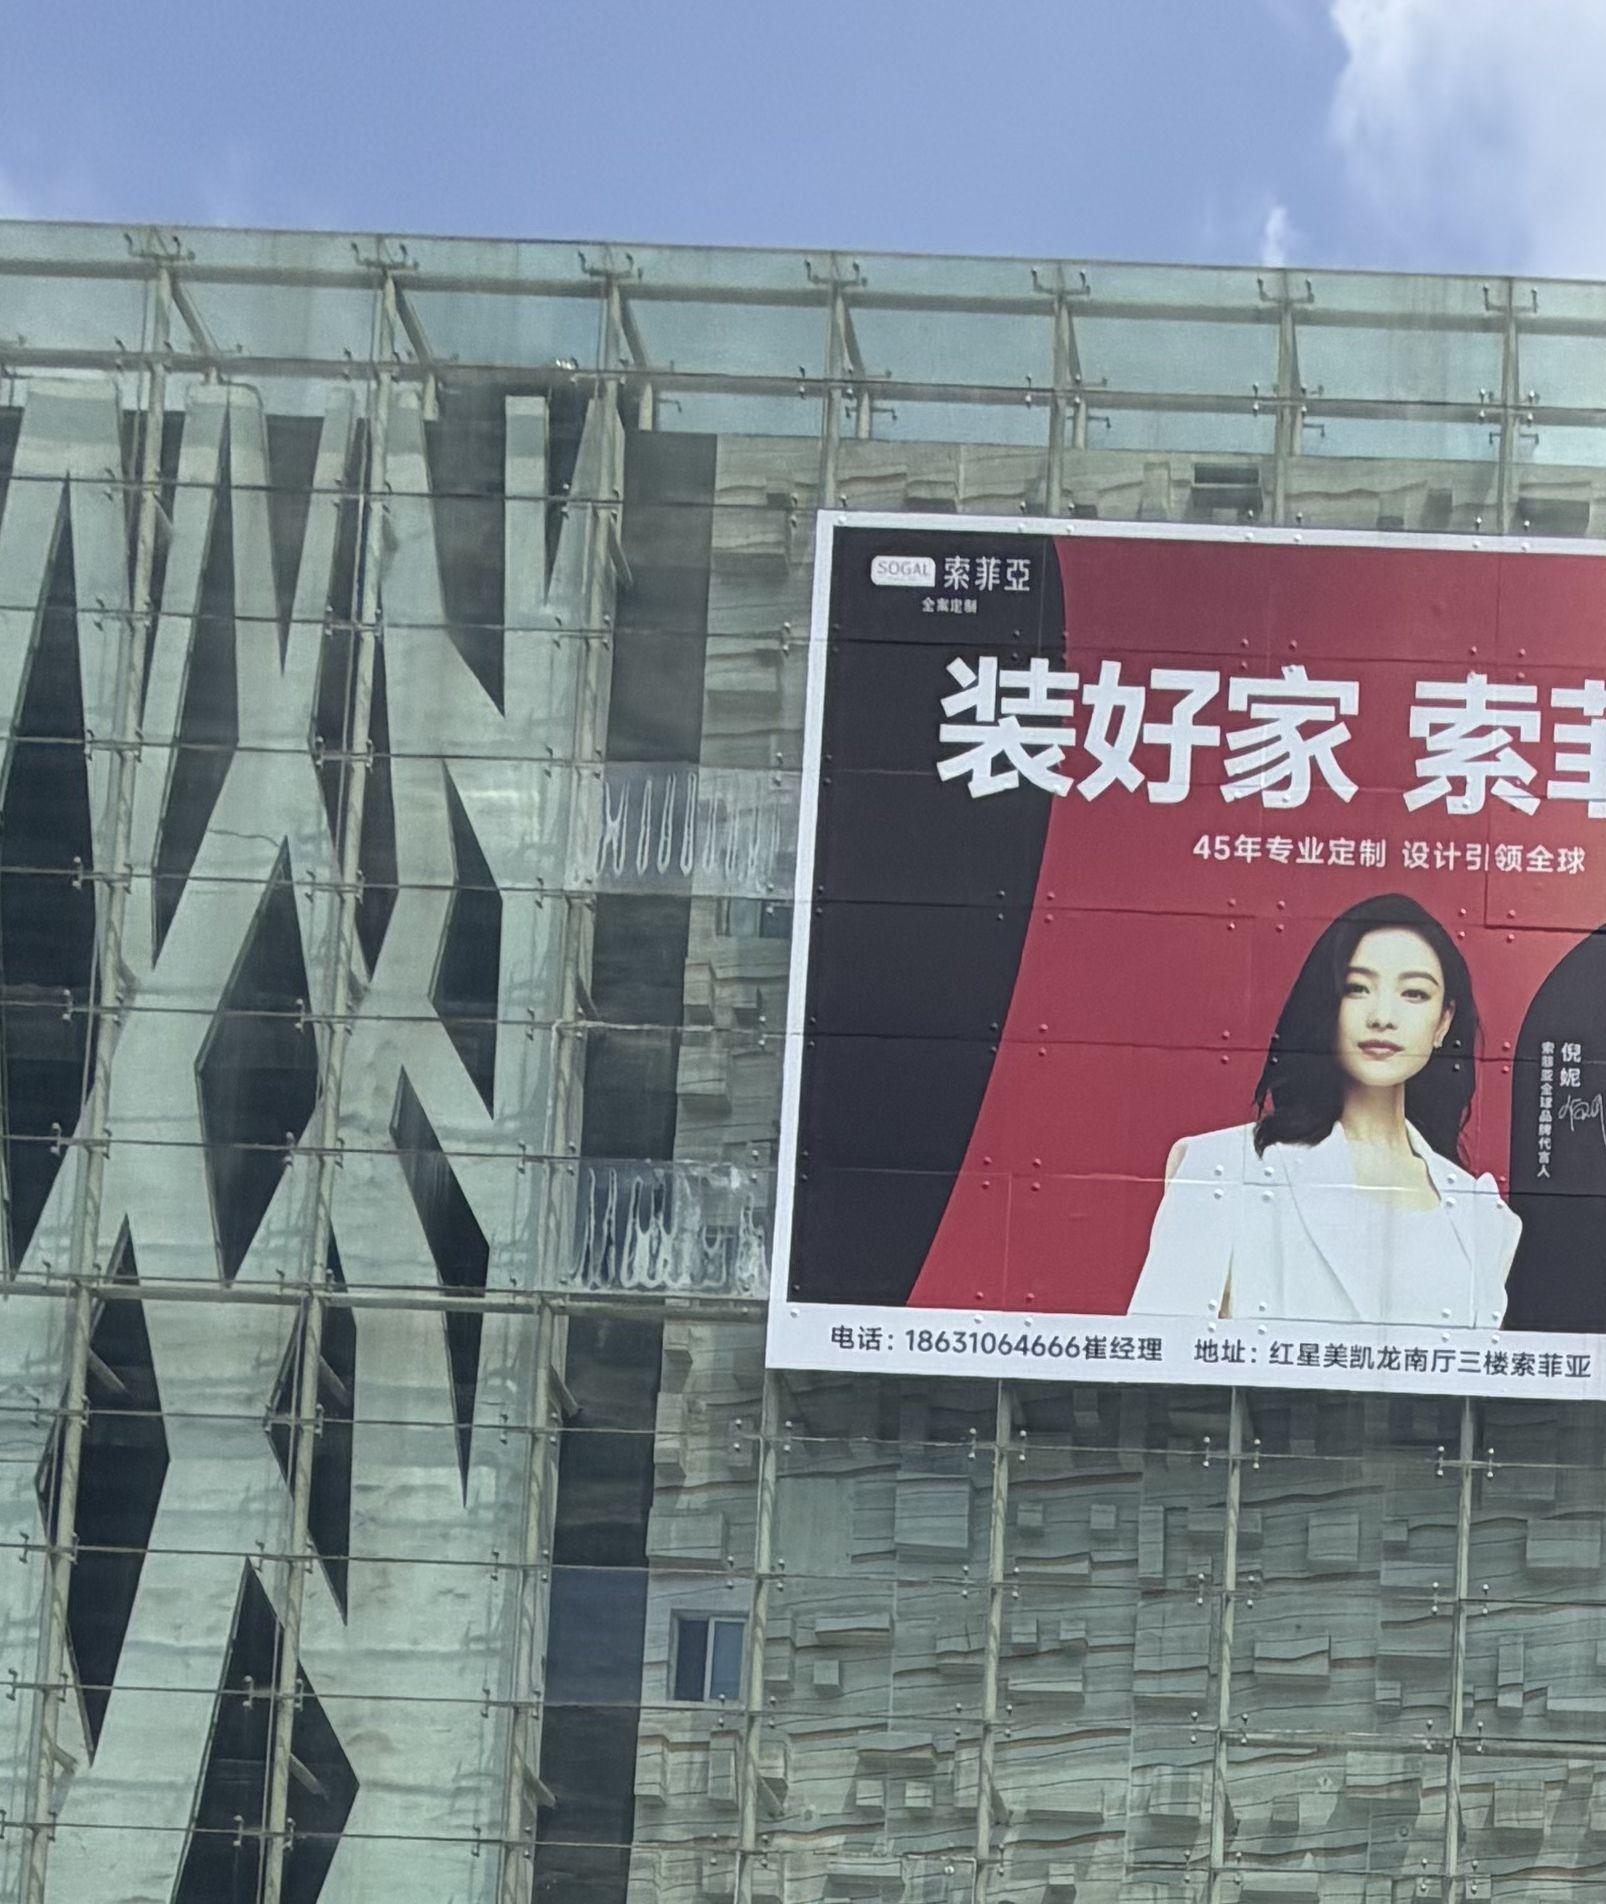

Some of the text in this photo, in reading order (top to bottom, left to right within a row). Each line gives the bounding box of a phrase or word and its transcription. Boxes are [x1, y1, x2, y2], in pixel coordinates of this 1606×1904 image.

[877, 560, 930, 577] SOGAL
[944, 556, 1031, 592] 索菲亞
[936, 655, 1359, 808] 装好家
[1193, 834, 1586, 875] 45年专业定制 设计引领全球
